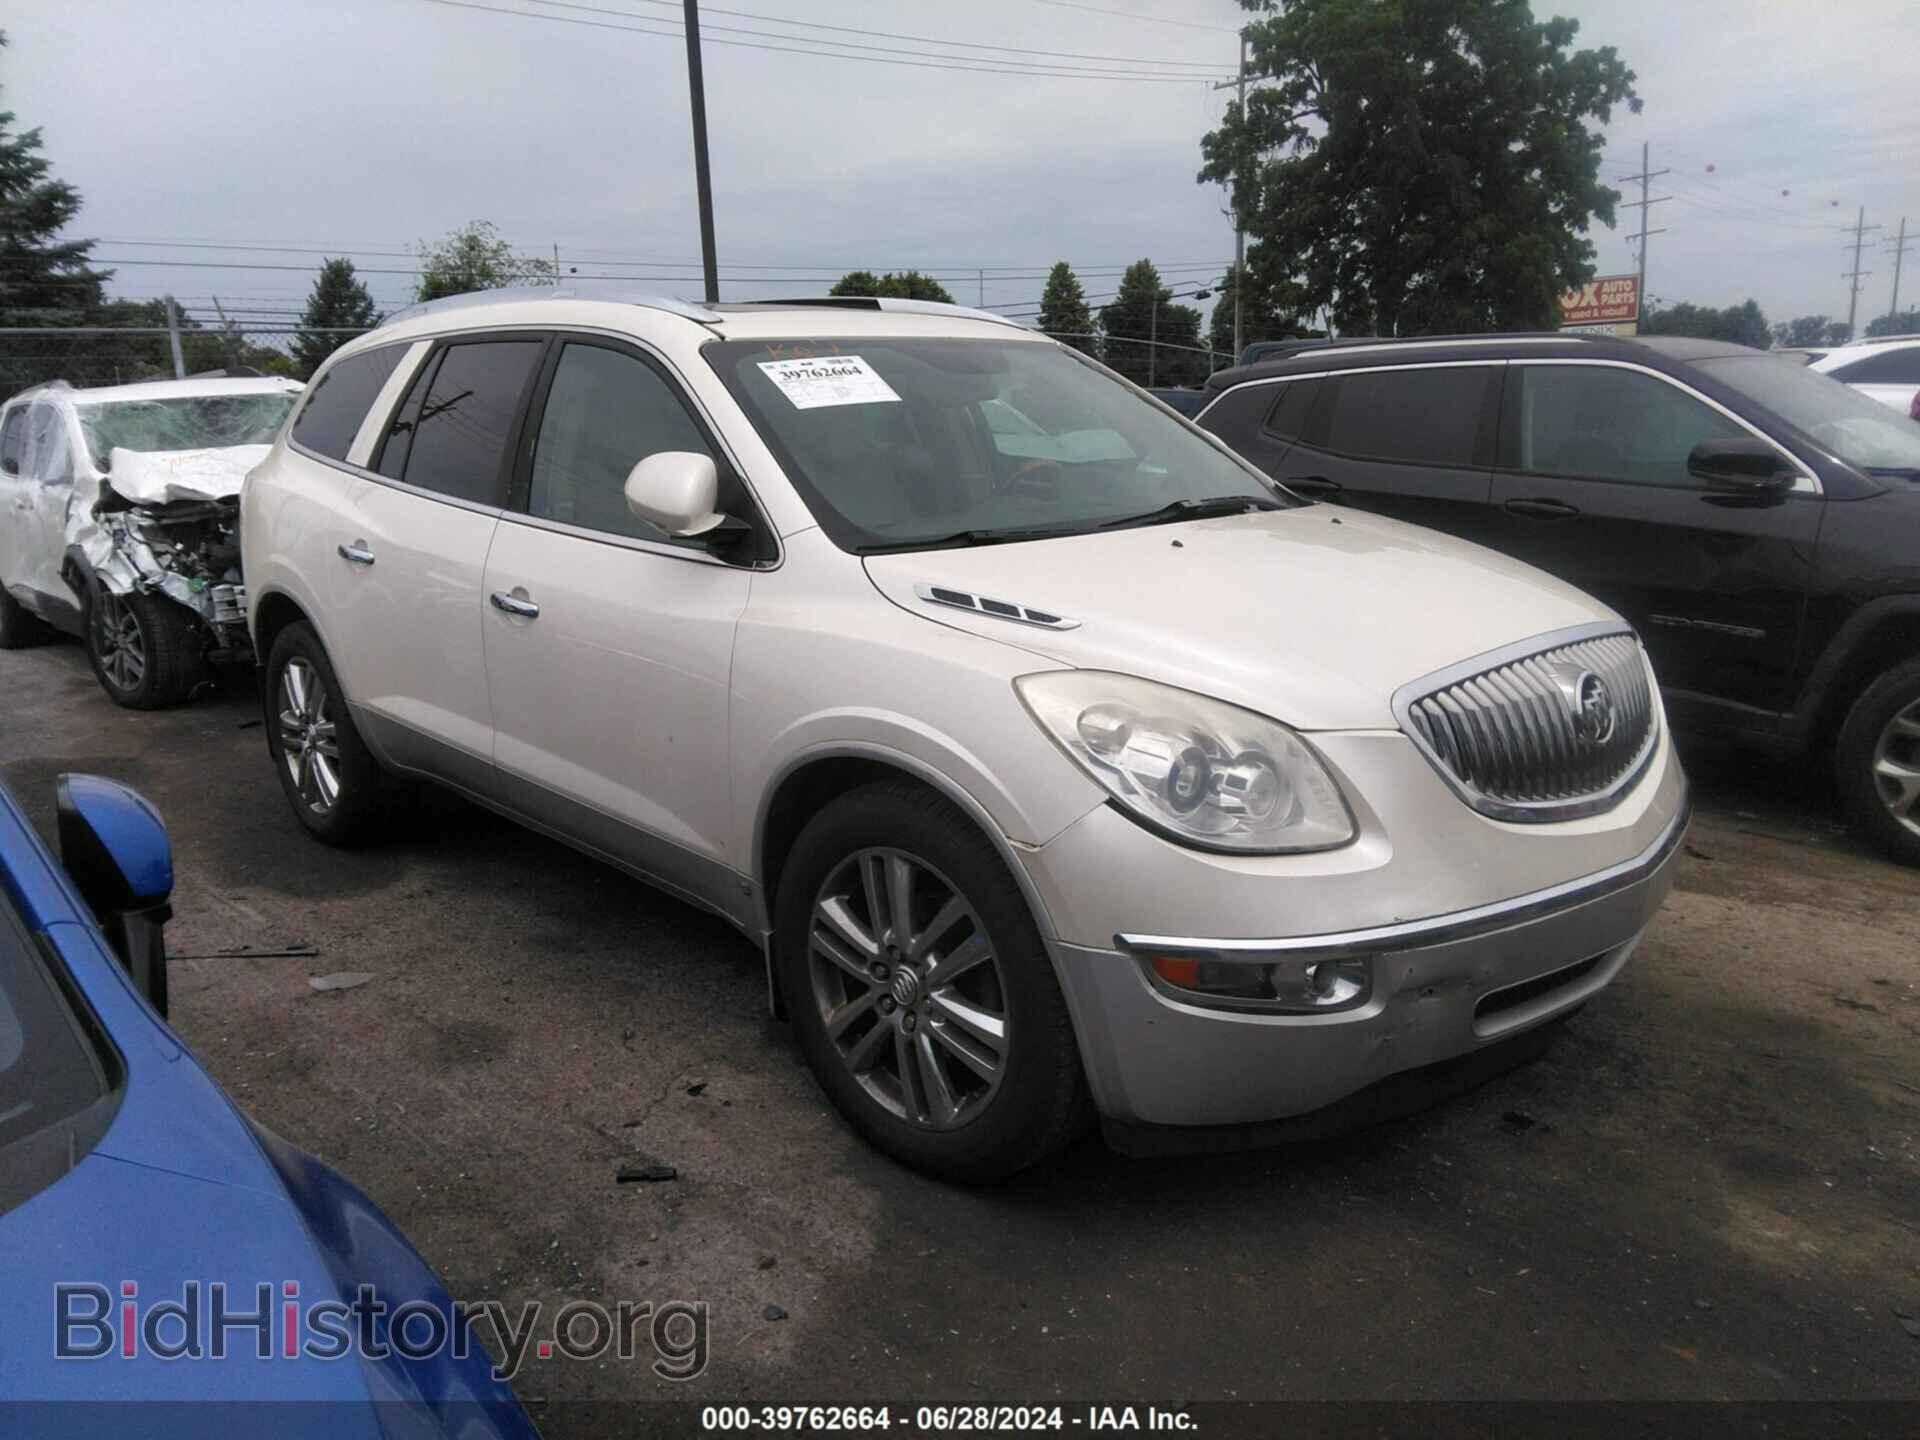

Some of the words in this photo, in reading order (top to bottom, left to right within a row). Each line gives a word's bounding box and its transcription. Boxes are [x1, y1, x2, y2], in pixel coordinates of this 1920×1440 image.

[1601, 280, 1633, 293] AUTO
[1601, 292, 1635, 305] PARTS
[779, 366, 862, 381] 39762664
